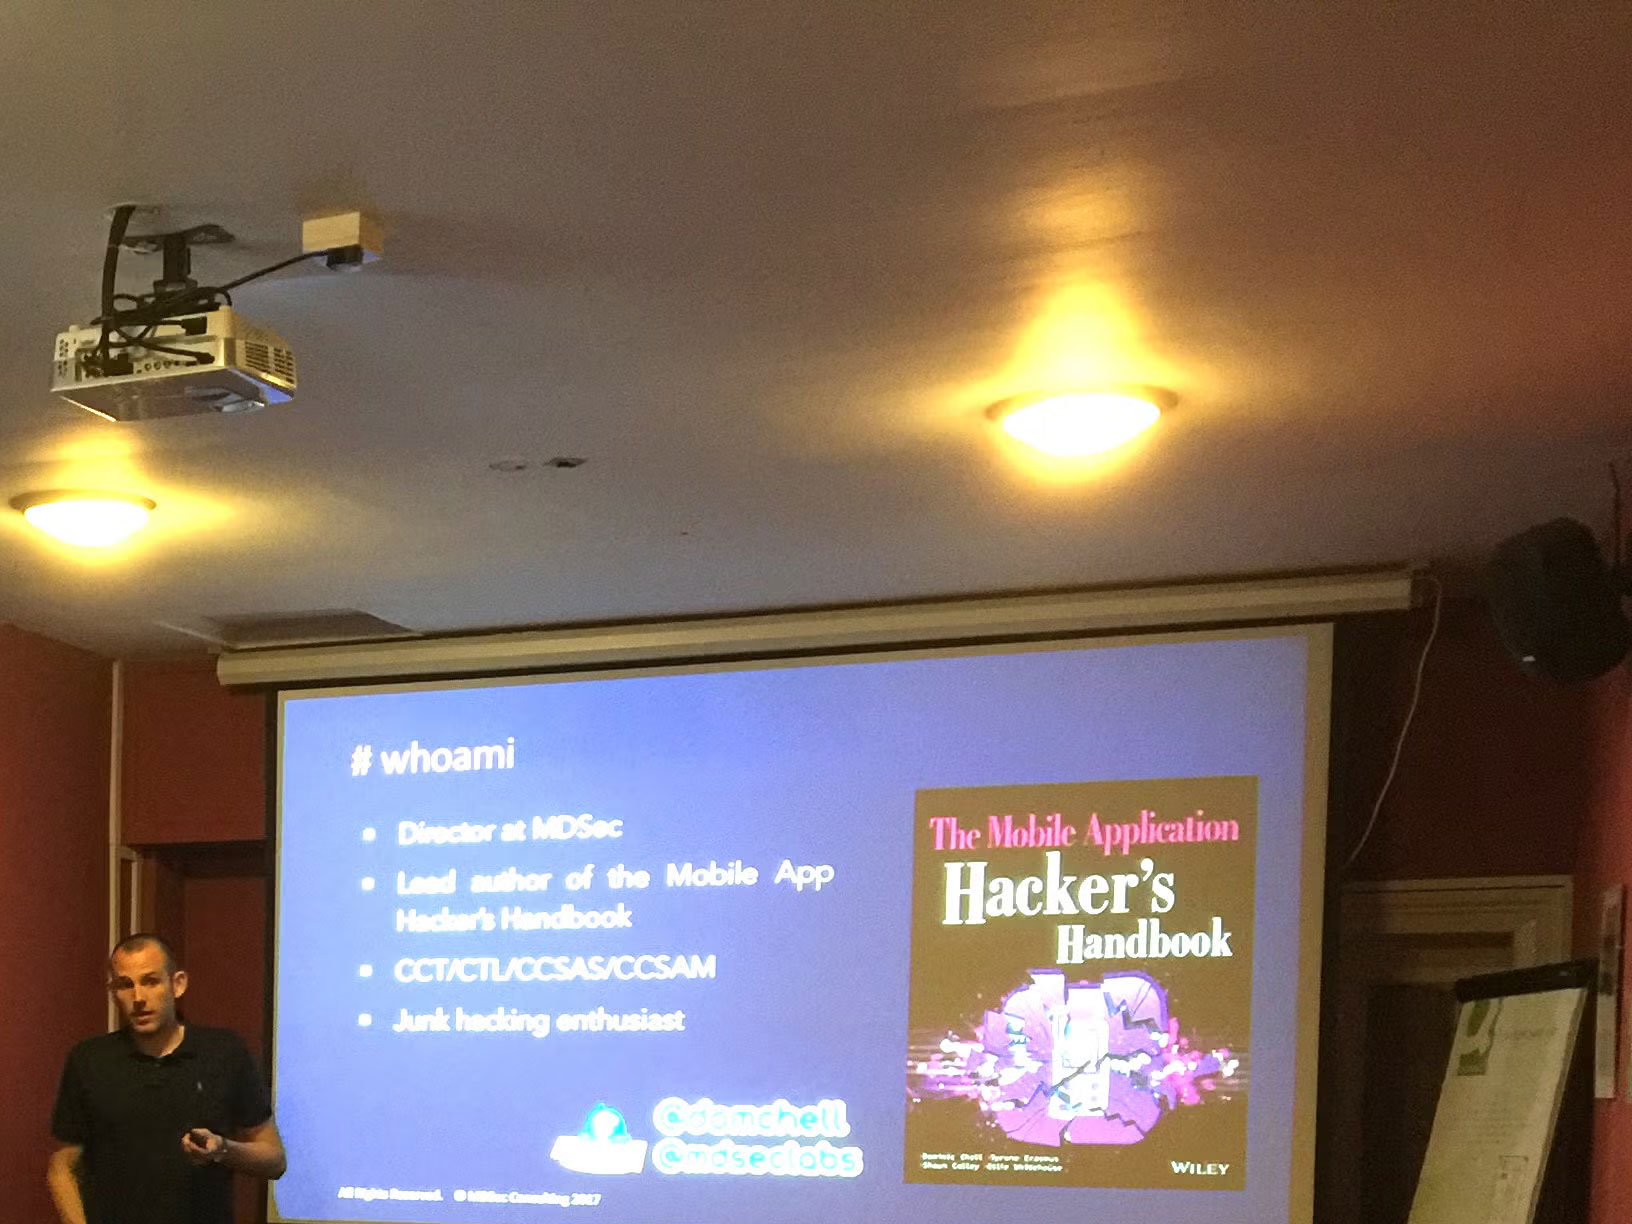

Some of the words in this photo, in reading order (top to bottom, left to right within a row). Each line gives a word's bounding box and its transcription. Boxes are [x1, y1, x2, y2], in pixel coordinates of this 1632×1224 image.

[351, 744, 373, 777] #
[380, 737, 515, 774] whoami
[397, 819, 495, 846] Director
[501, 820, 527, 842] at
[532, 814, 624, 842] MDSec
[930, 816, 981, 850] The
[987, 813, 1076, 849] Mobile
[1087, 810, 1239, 855] Application
[397, 869, 457, 895] Lead
[470, 865, 552, 893] author
[565, 863, 595, 891] of
[607, 863, 651, 890] the
[666, 859, 759, 888] Mobile
[774, 858, 835, 892] App
[942, 850, 1176, 925] Hacker's
[396, 905, 497, 933] Hacker's
[500, 902, 633, 932] Handbook
[1055, 916, 1233, 964] Handbook
[394, 954, 717, 984] CCT/CTL/CCSAS/CCSAM
[392, 1006, 450, 1034] Junk
[455, 1006, 551, 1039] hacking
[556, 1006, 686, 1033] enthusiast
[1171, 1160, 1230, 1176] WILEY
